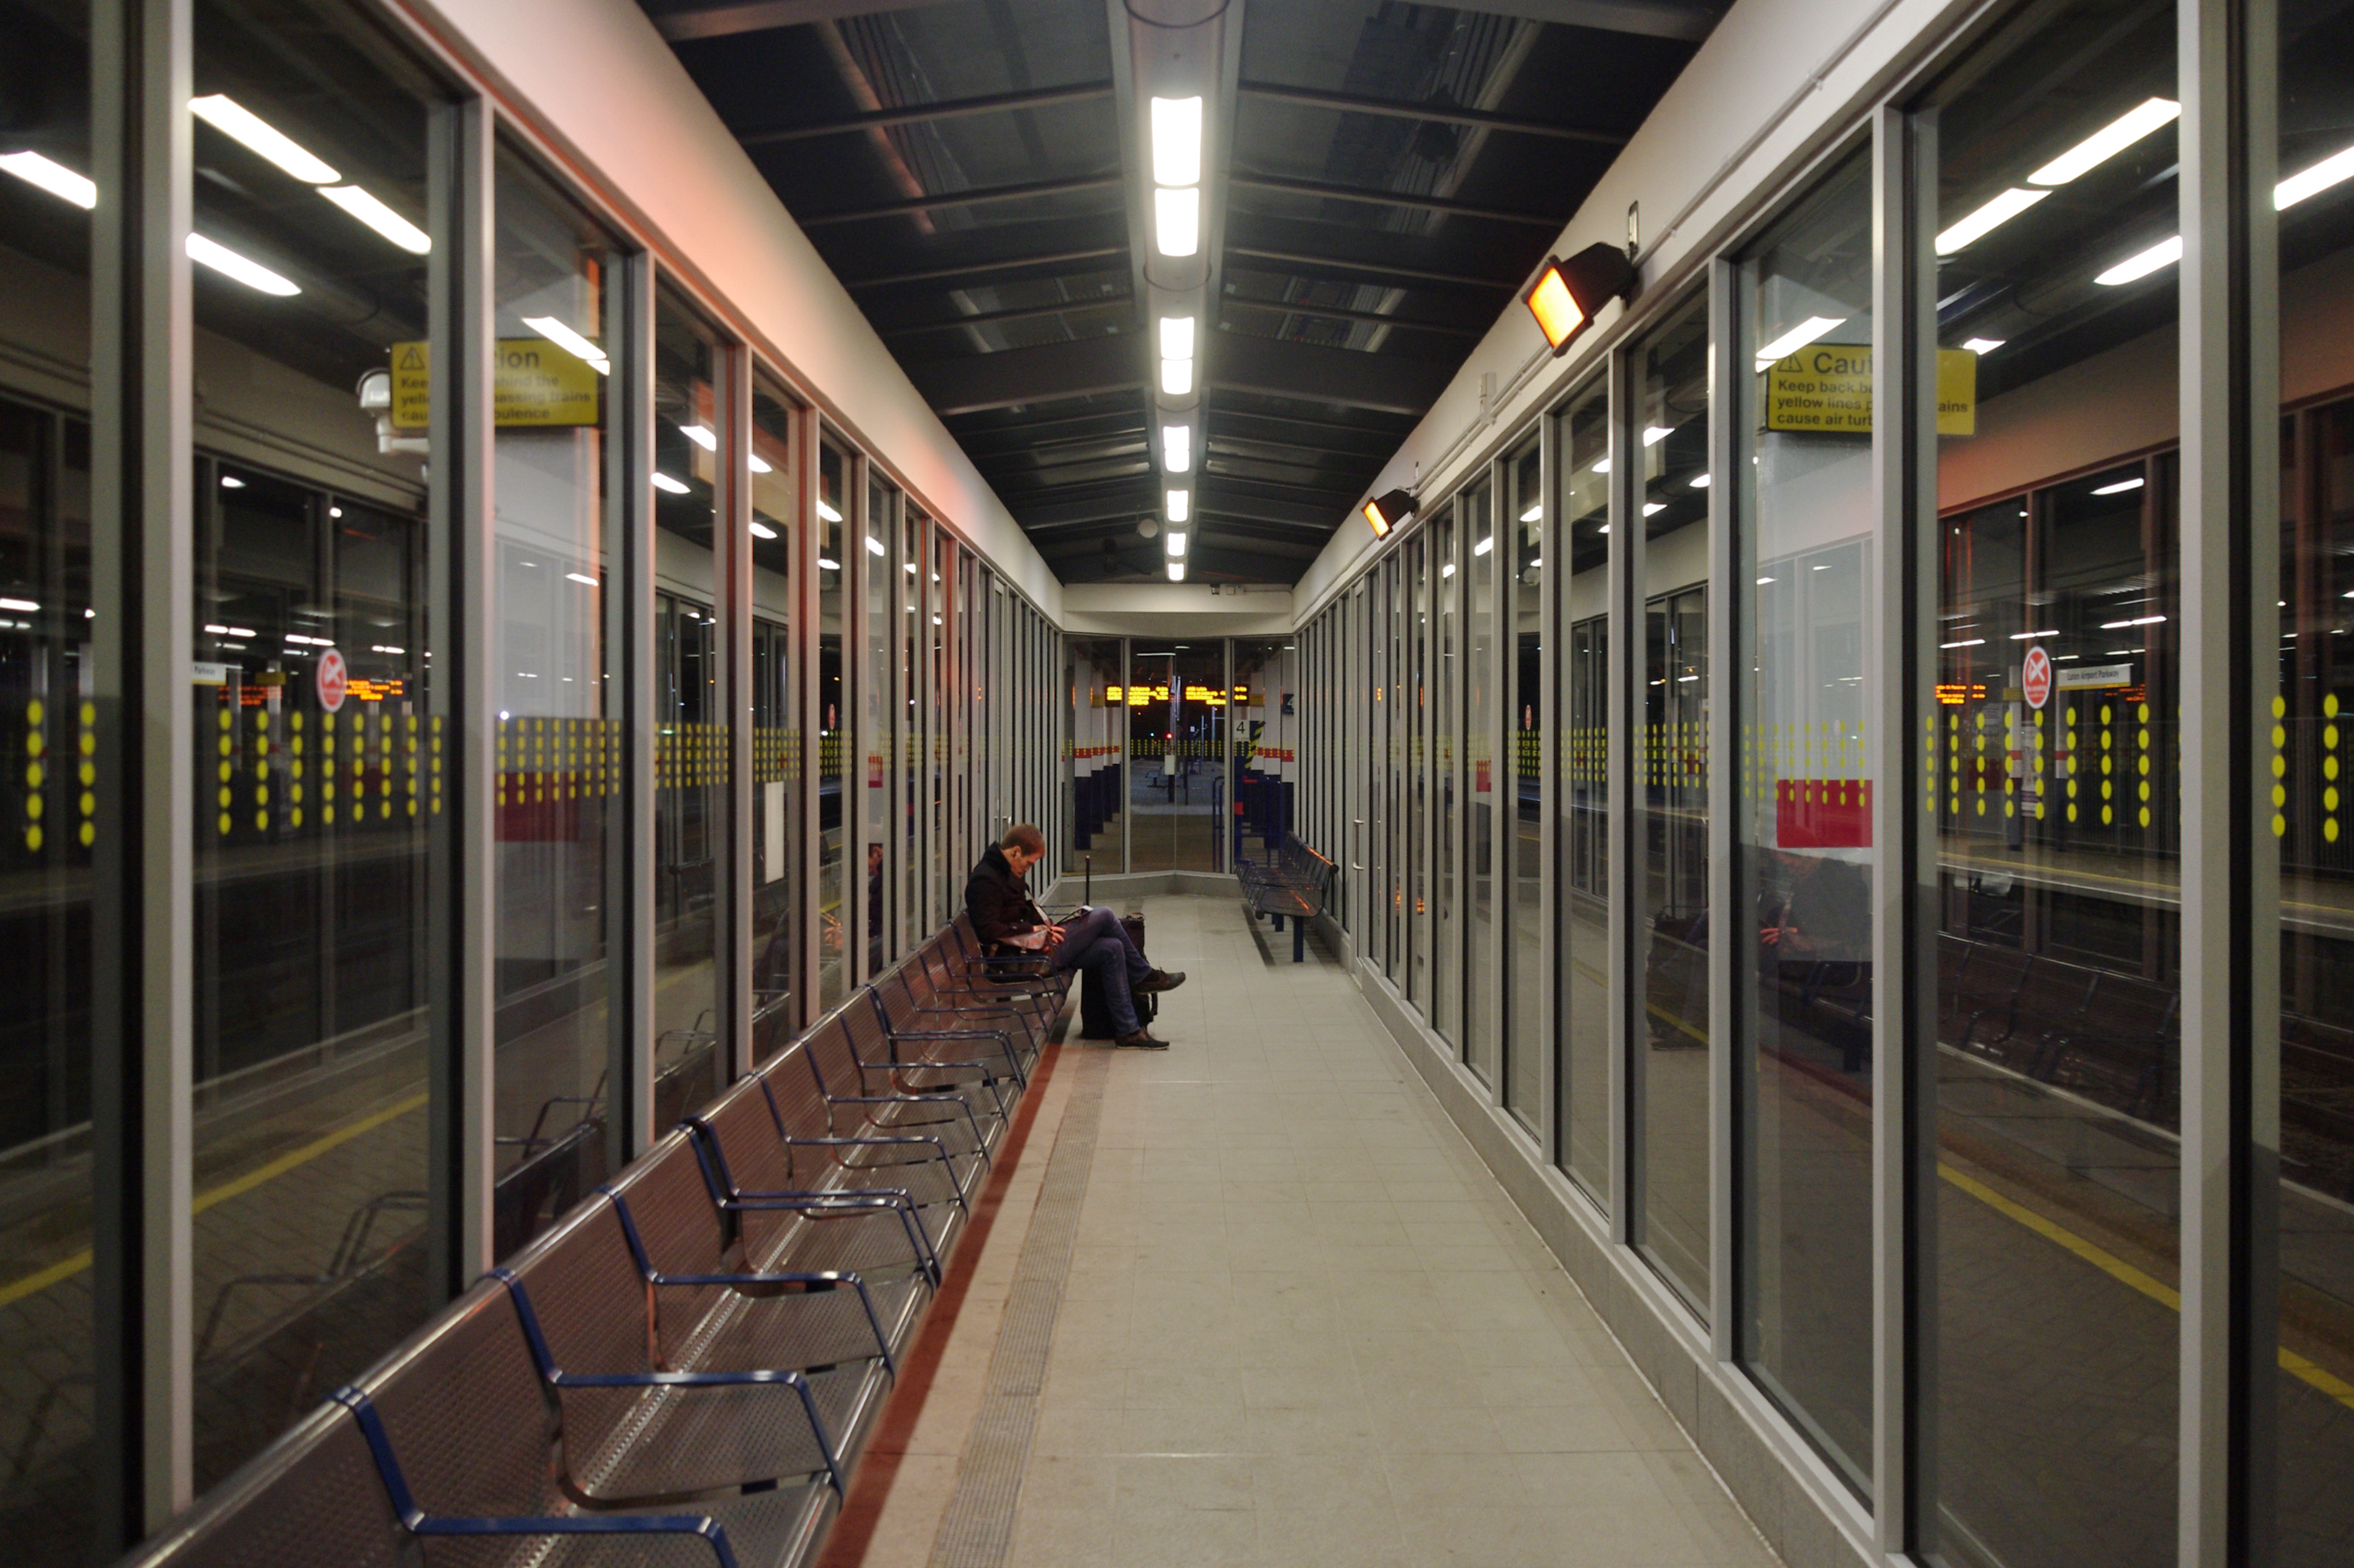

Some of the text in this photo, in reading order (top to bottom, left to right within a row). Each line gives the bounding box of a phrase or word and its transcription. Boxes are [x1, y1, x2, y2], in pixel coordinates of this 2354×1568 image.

[1814, 352, 1873, 375] Caut
[401, 377, 429, 390] Kee
[1778, 379, 1815, 394] Keep
[1819, 381, 1855, 393] back
[1777, 396, 1823, 410] yellow
[1827, 398, 1861, 409] lines
[1938, 400, 1968, 413] ains
[401, 411, 428, 422] cau
[1777, 414, 1820, 424] cause
[1826, 413, 1843, 425] air
[1236, 720, 1246, 734] 4
